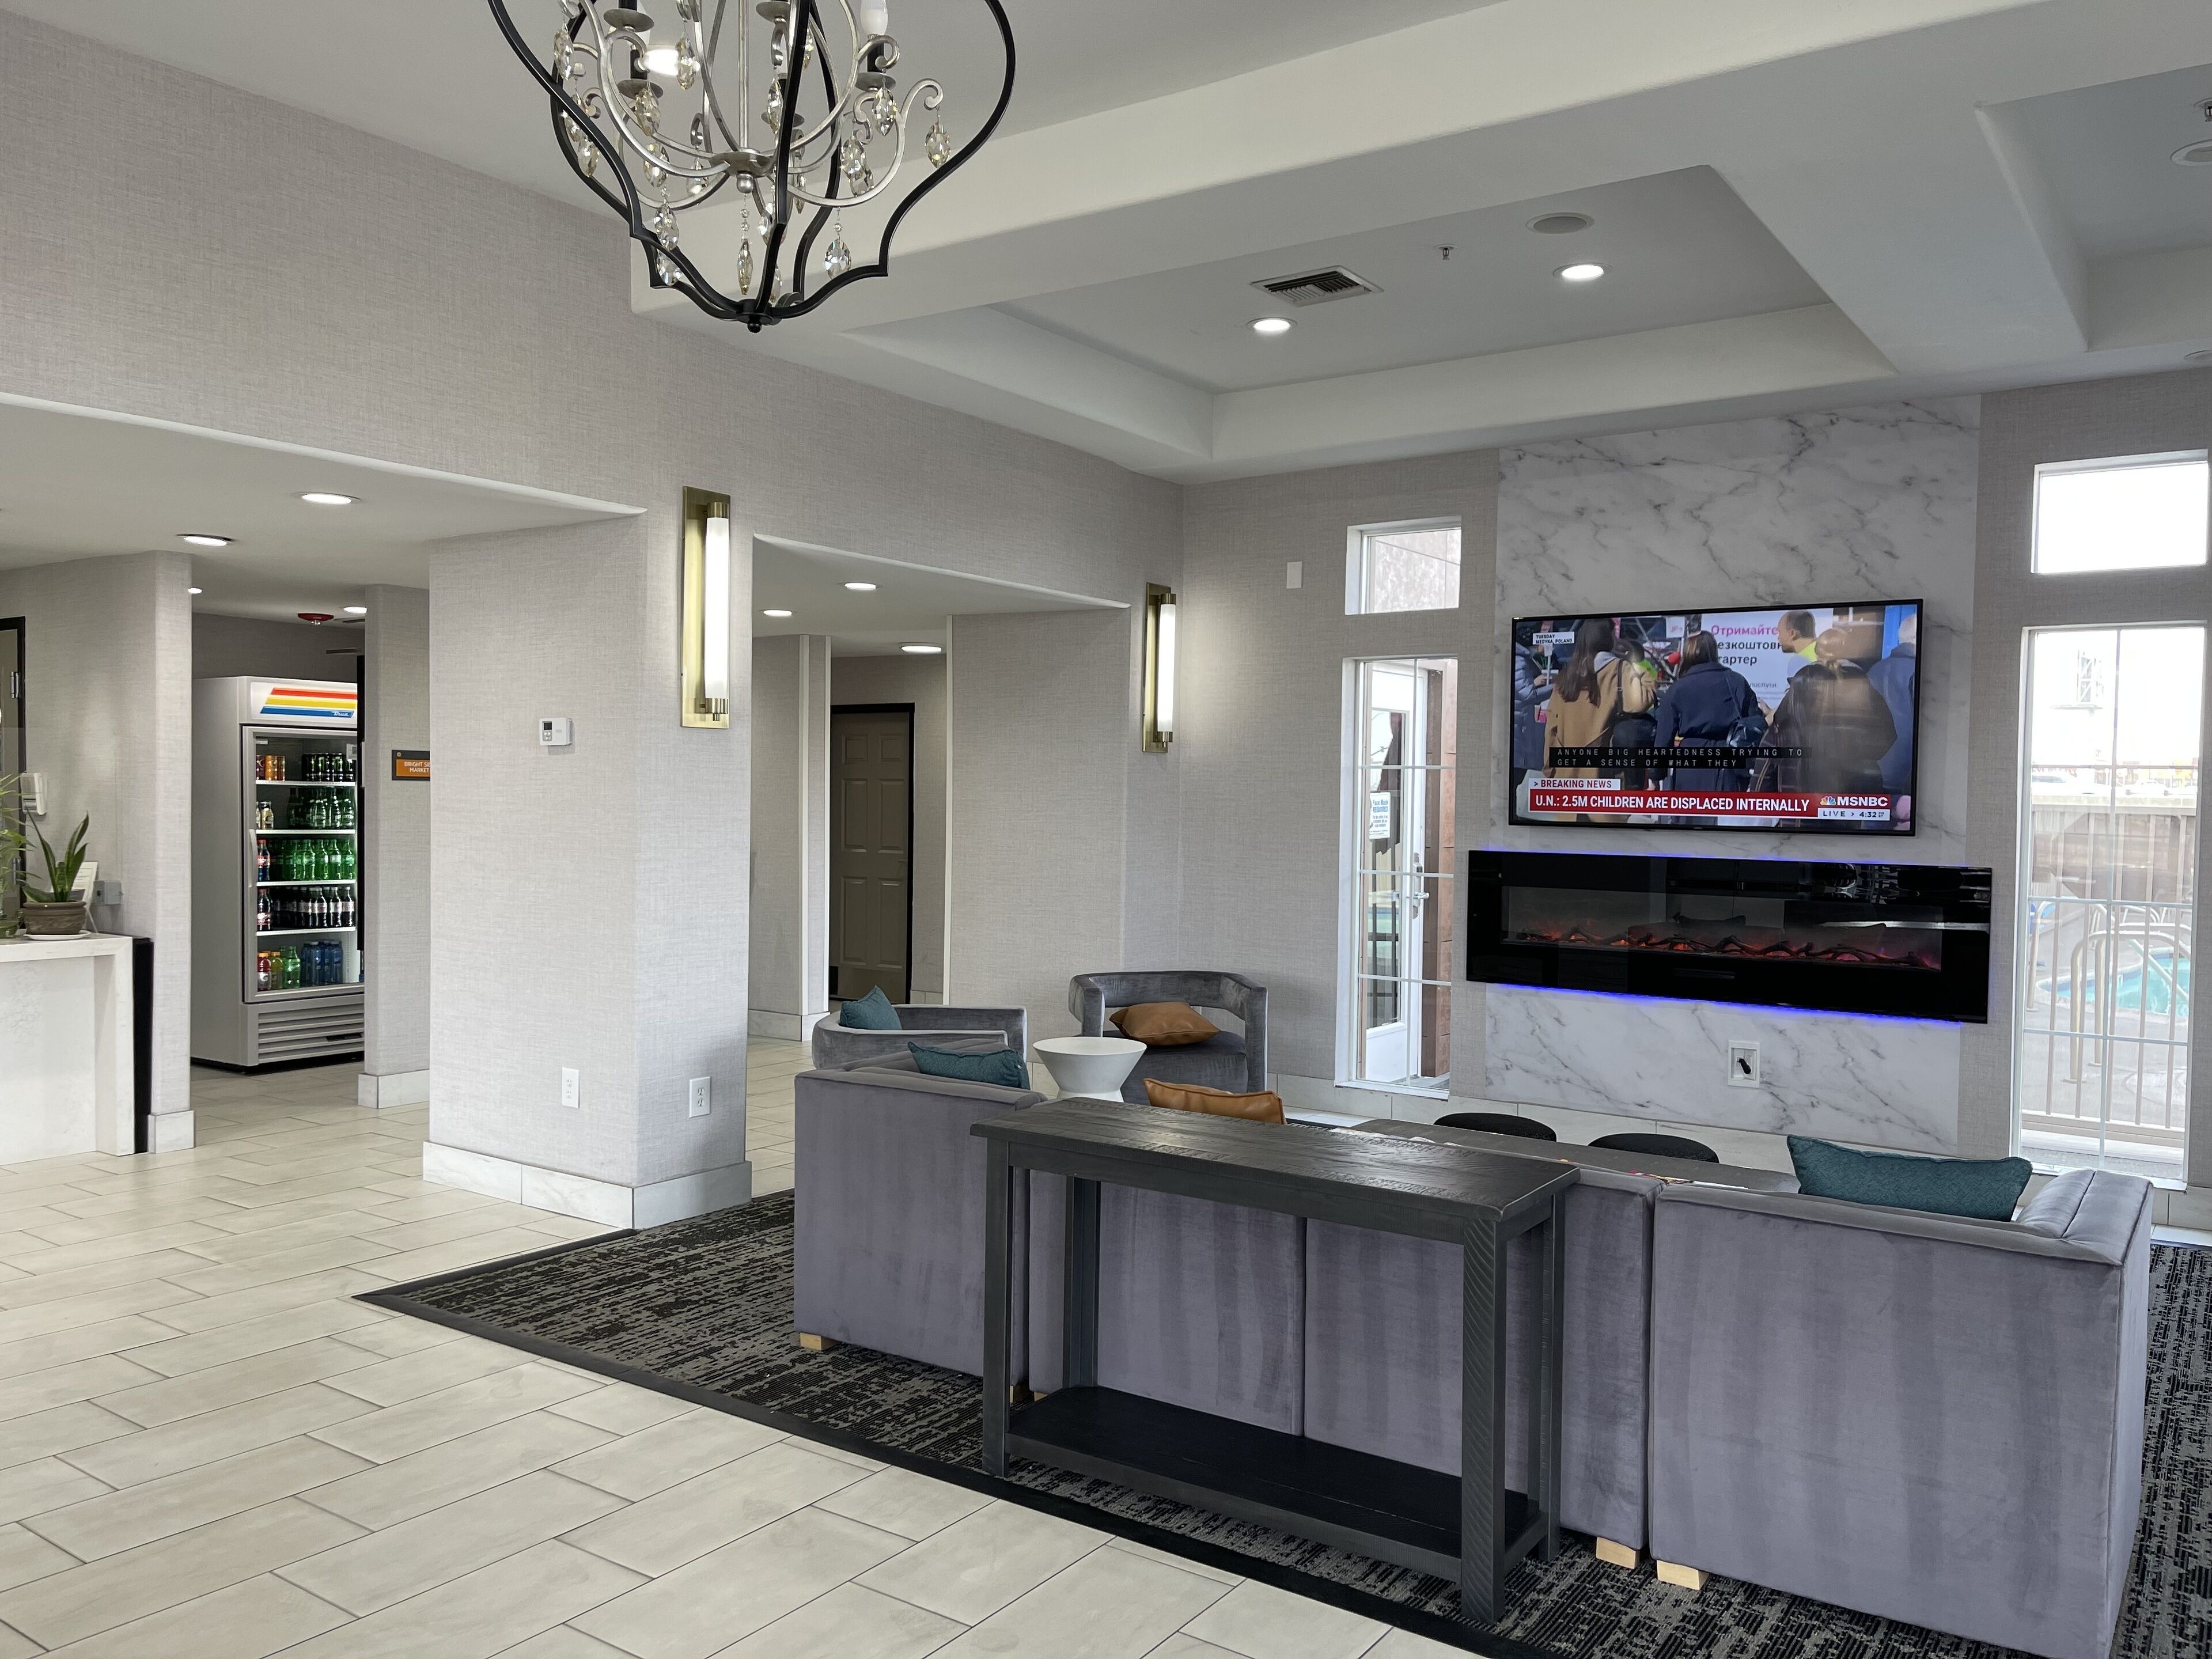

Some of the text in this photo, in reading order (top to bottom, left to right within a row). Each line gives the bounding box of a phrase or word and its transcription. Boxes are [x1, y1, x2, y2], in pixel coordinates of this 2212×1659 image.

[1711, 624, 1778, 637] Отримайте
[1541, 779, 1612, 788] BREAKING NEWS
[1536, 795, 1810, 812] U.N.: 2.5M CHILDREN ARE DISPLACED INTERNALLY
[1837, 796, 1888, 807] MSNBC
